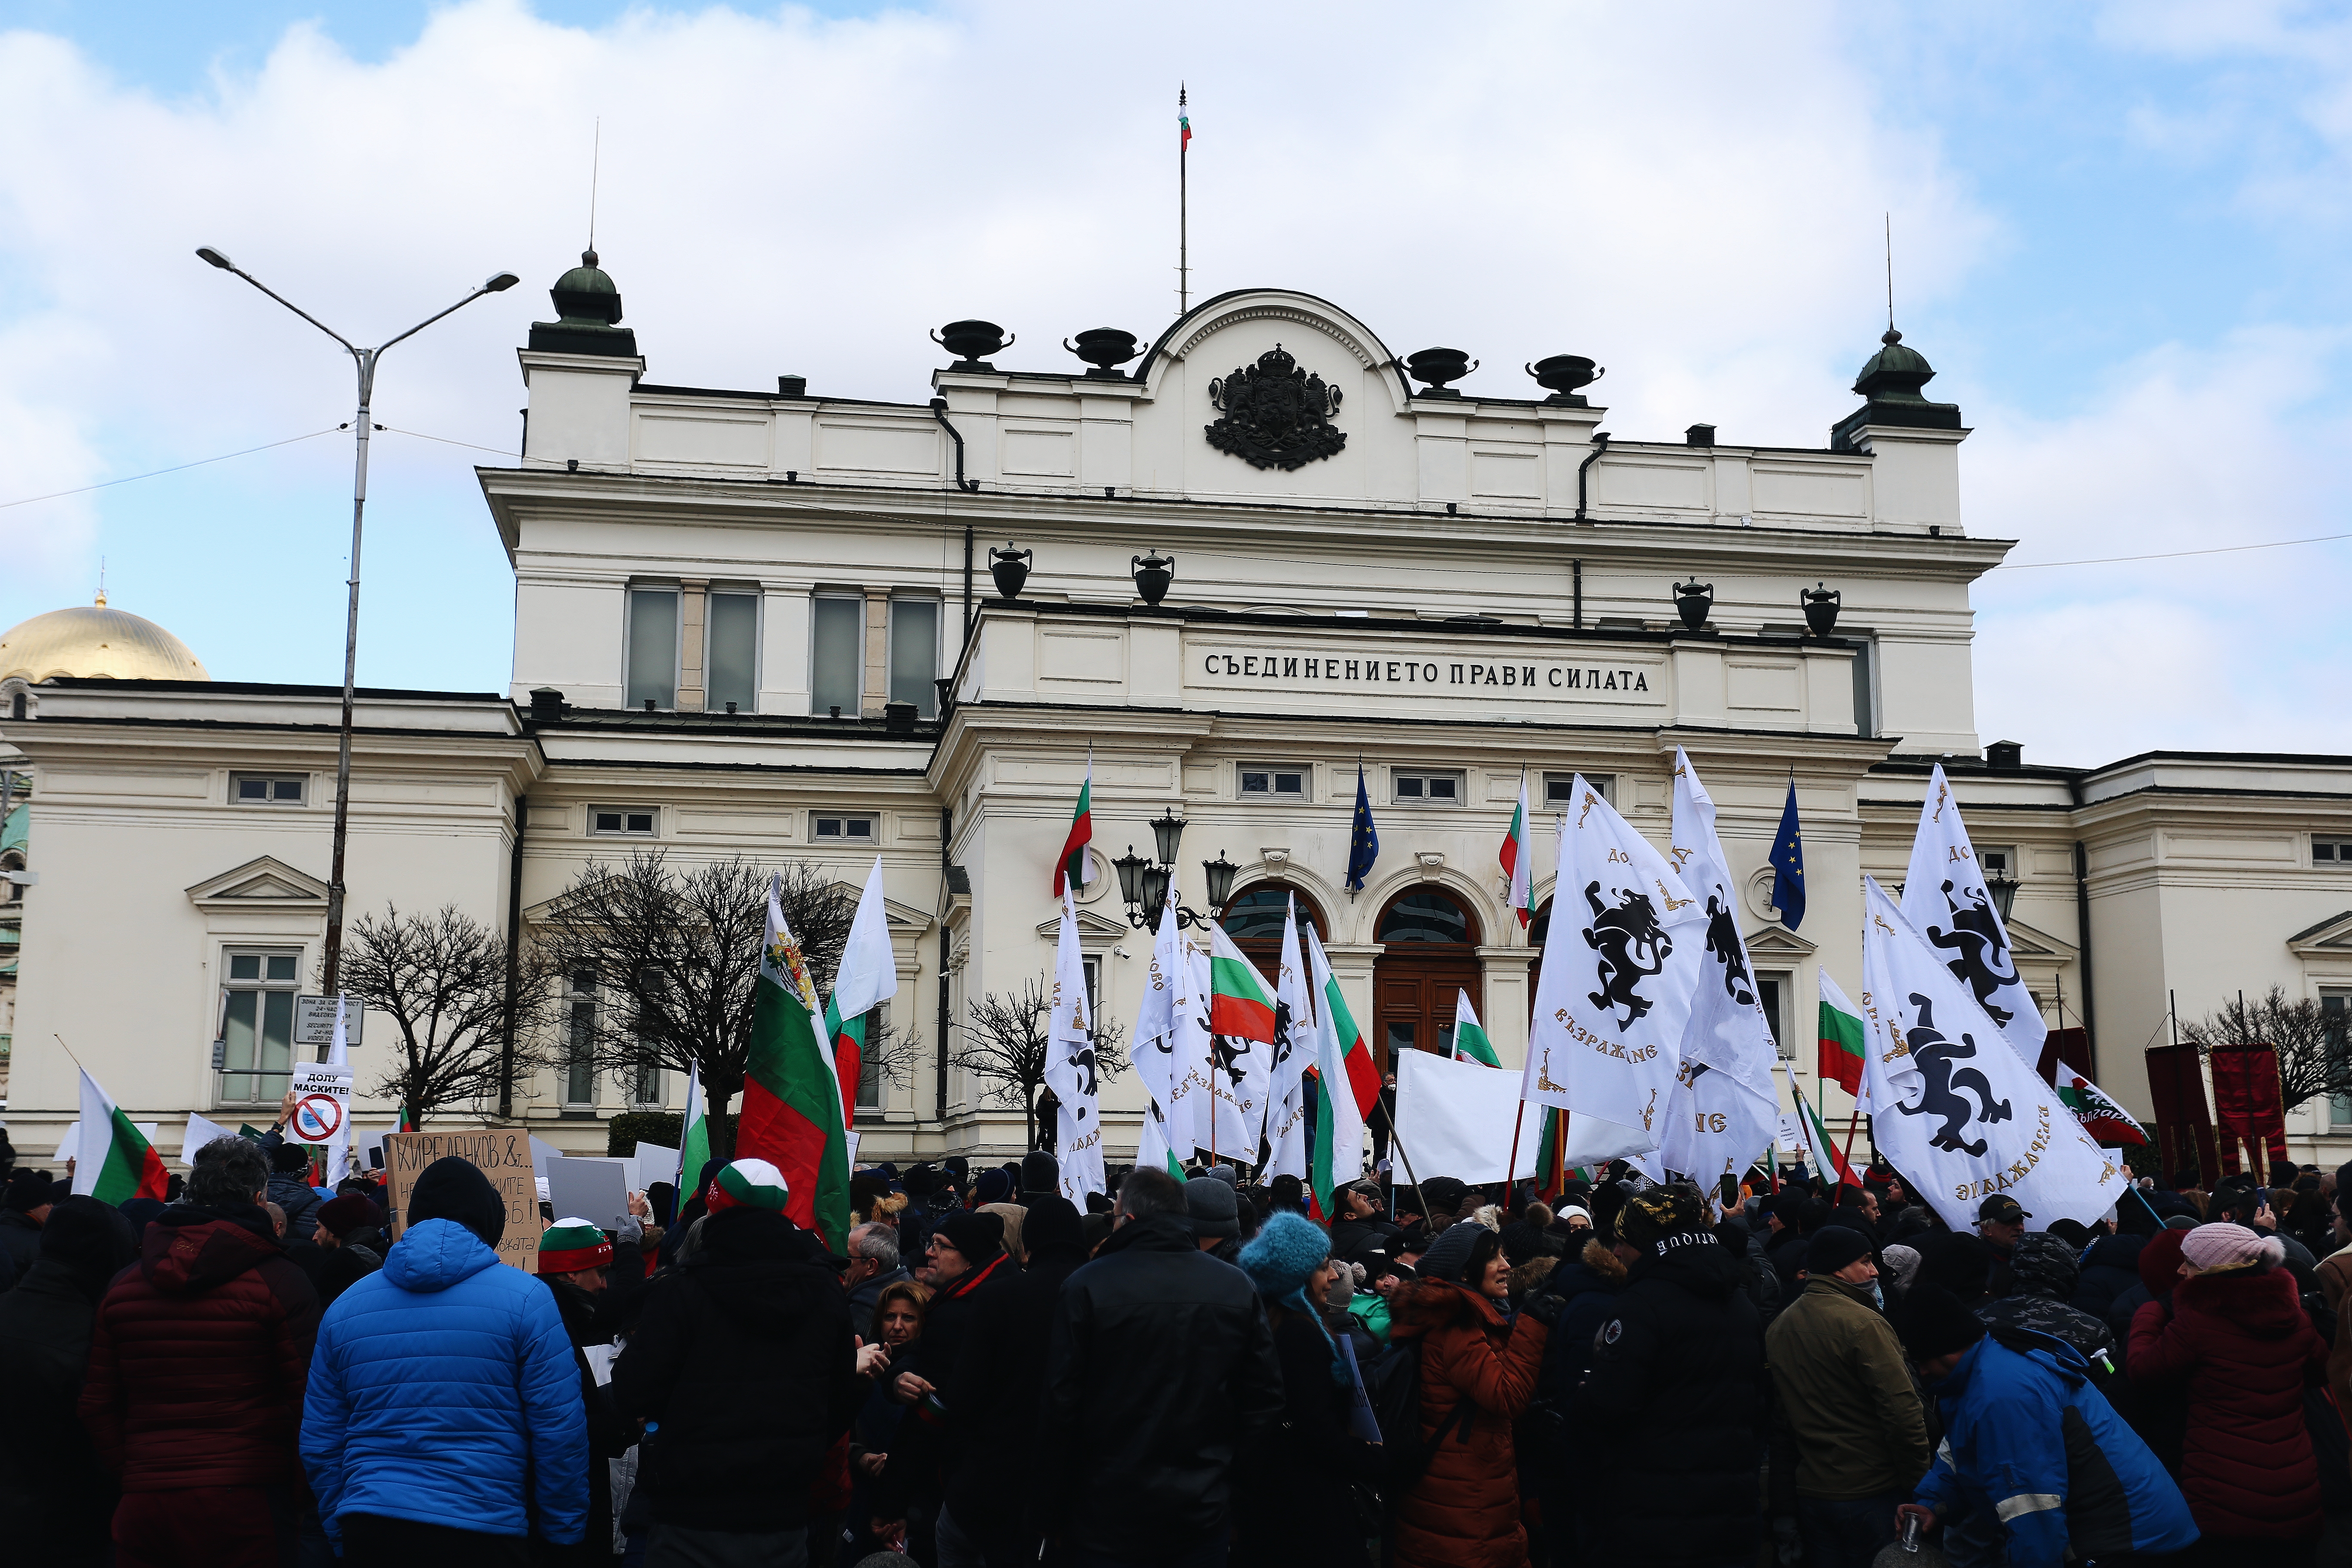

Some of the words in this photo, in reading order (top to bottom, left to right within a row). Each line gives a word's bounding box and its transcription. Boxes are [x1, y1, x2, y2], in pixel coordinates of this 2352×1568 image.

[1205, 654, 1438, 682] СЪЕДИНЕНИЕТО
[1450, 664, 1536, 686] ПРАВИ
[1548, 668, 1649, 691] СИЛАТА
[307, 1073, 338, 1083] ДОЛУ
[293, 1083, 350, 1095] МАСКИТЕ!
